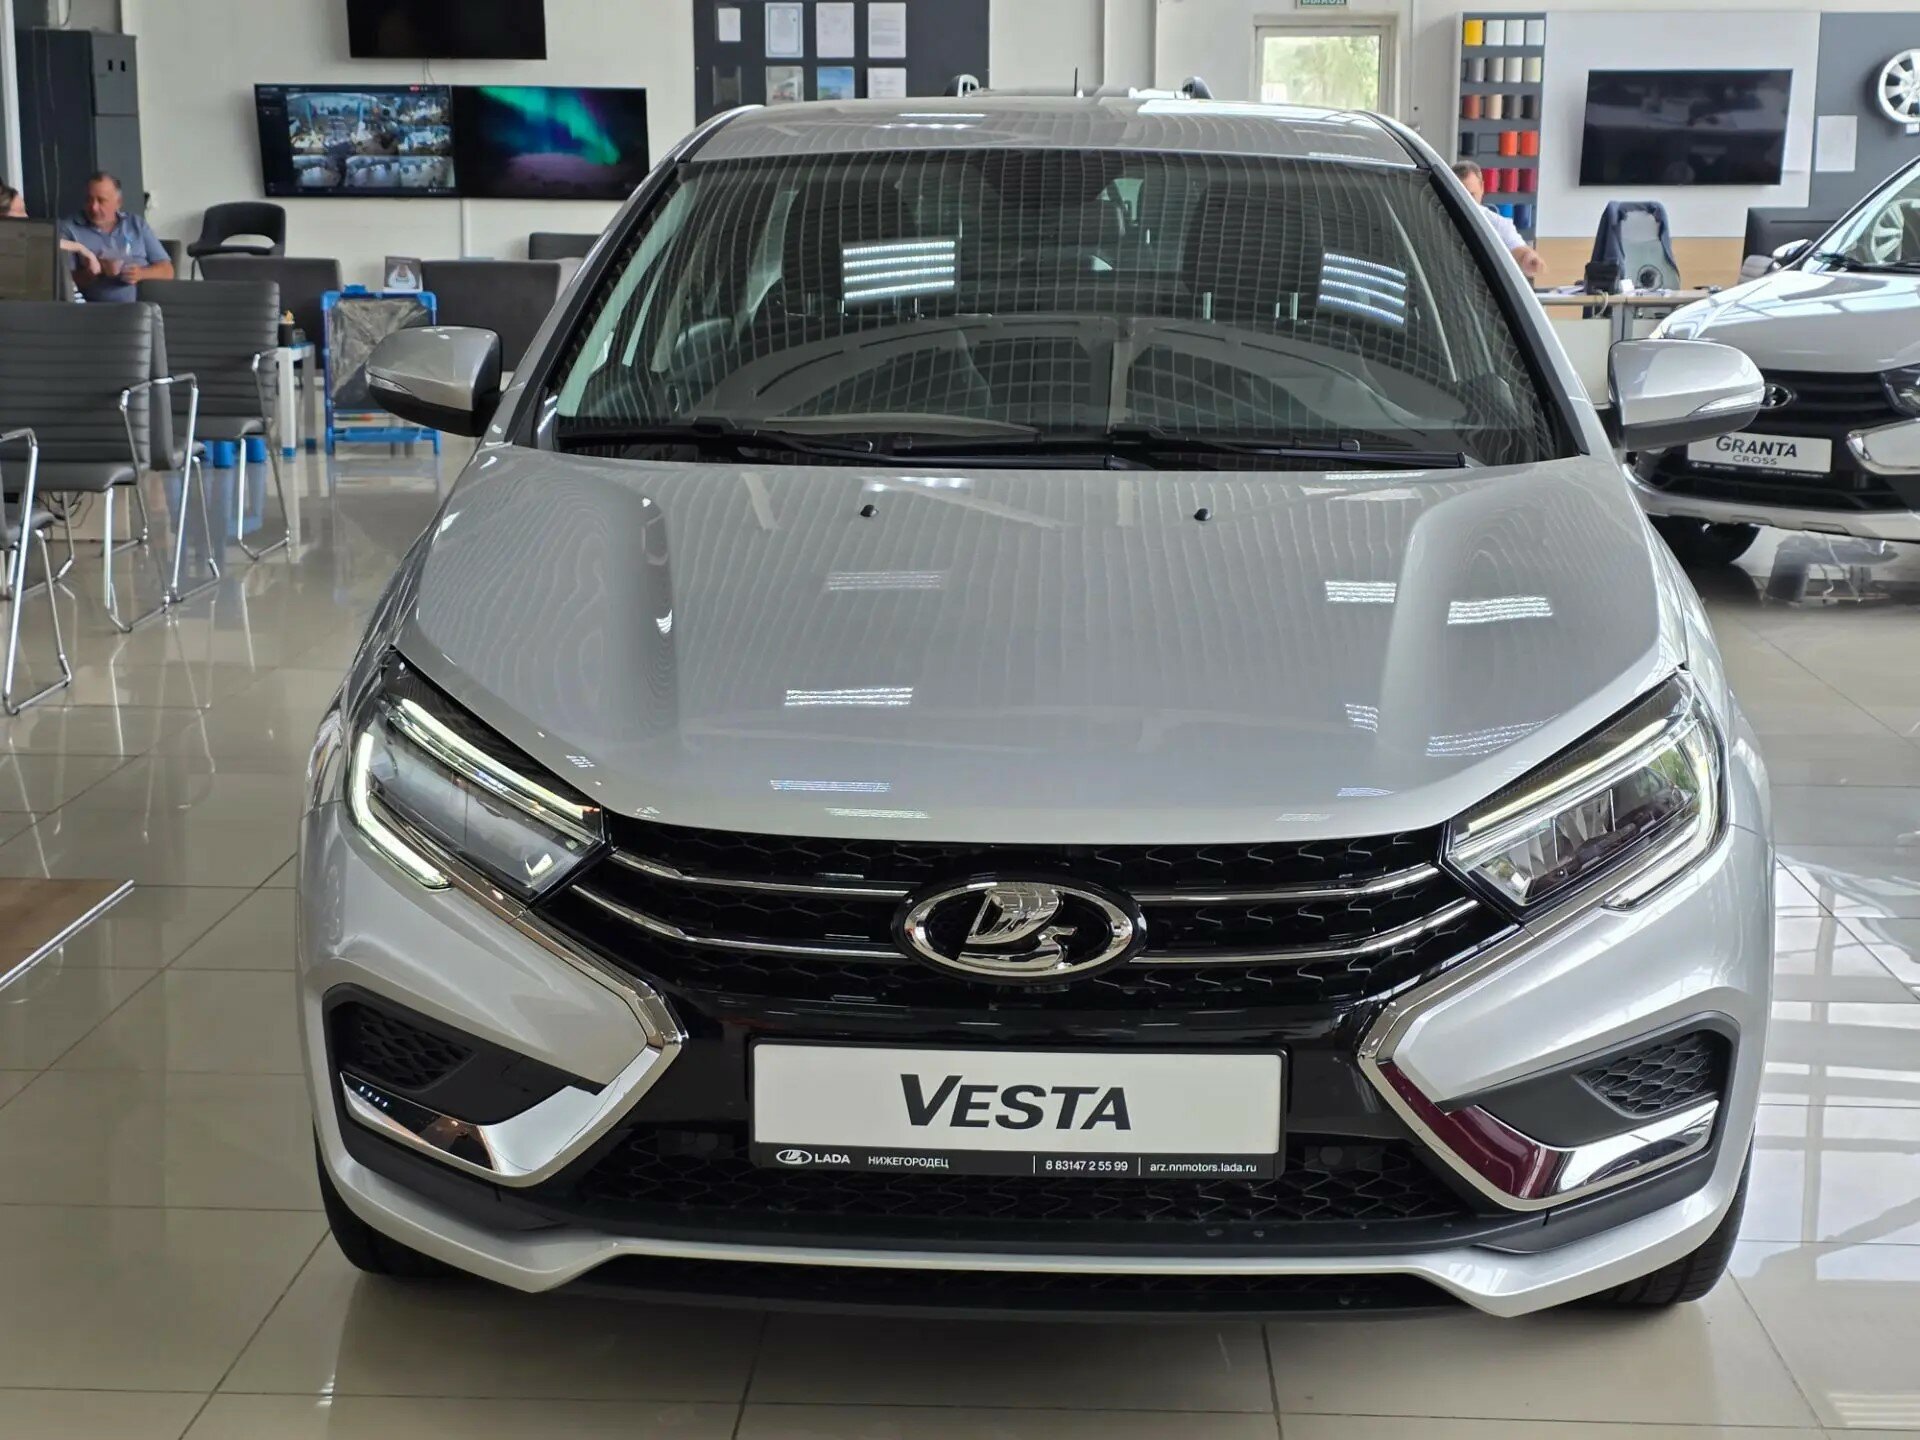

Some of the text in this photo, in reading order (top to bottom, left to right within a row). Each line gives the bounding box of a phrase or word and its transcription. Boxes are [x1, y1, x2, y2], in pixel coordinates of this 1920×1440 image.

[1716, 436, 1797, 457] GRANTA
[1733, 455, 1778, 465] CROSS
[900, 1073, 1132, 1131] VESTA
[814, 1153, 850, 1164] LADA
[868, 1156, 949, 1168] НИЖЕГОРОДЕЦ
[1045, 1160, 1129, 1172] 8 83147 2 55 99
[1150, 1161, 1257, 1173] arz.nnmotors.lada.ru
